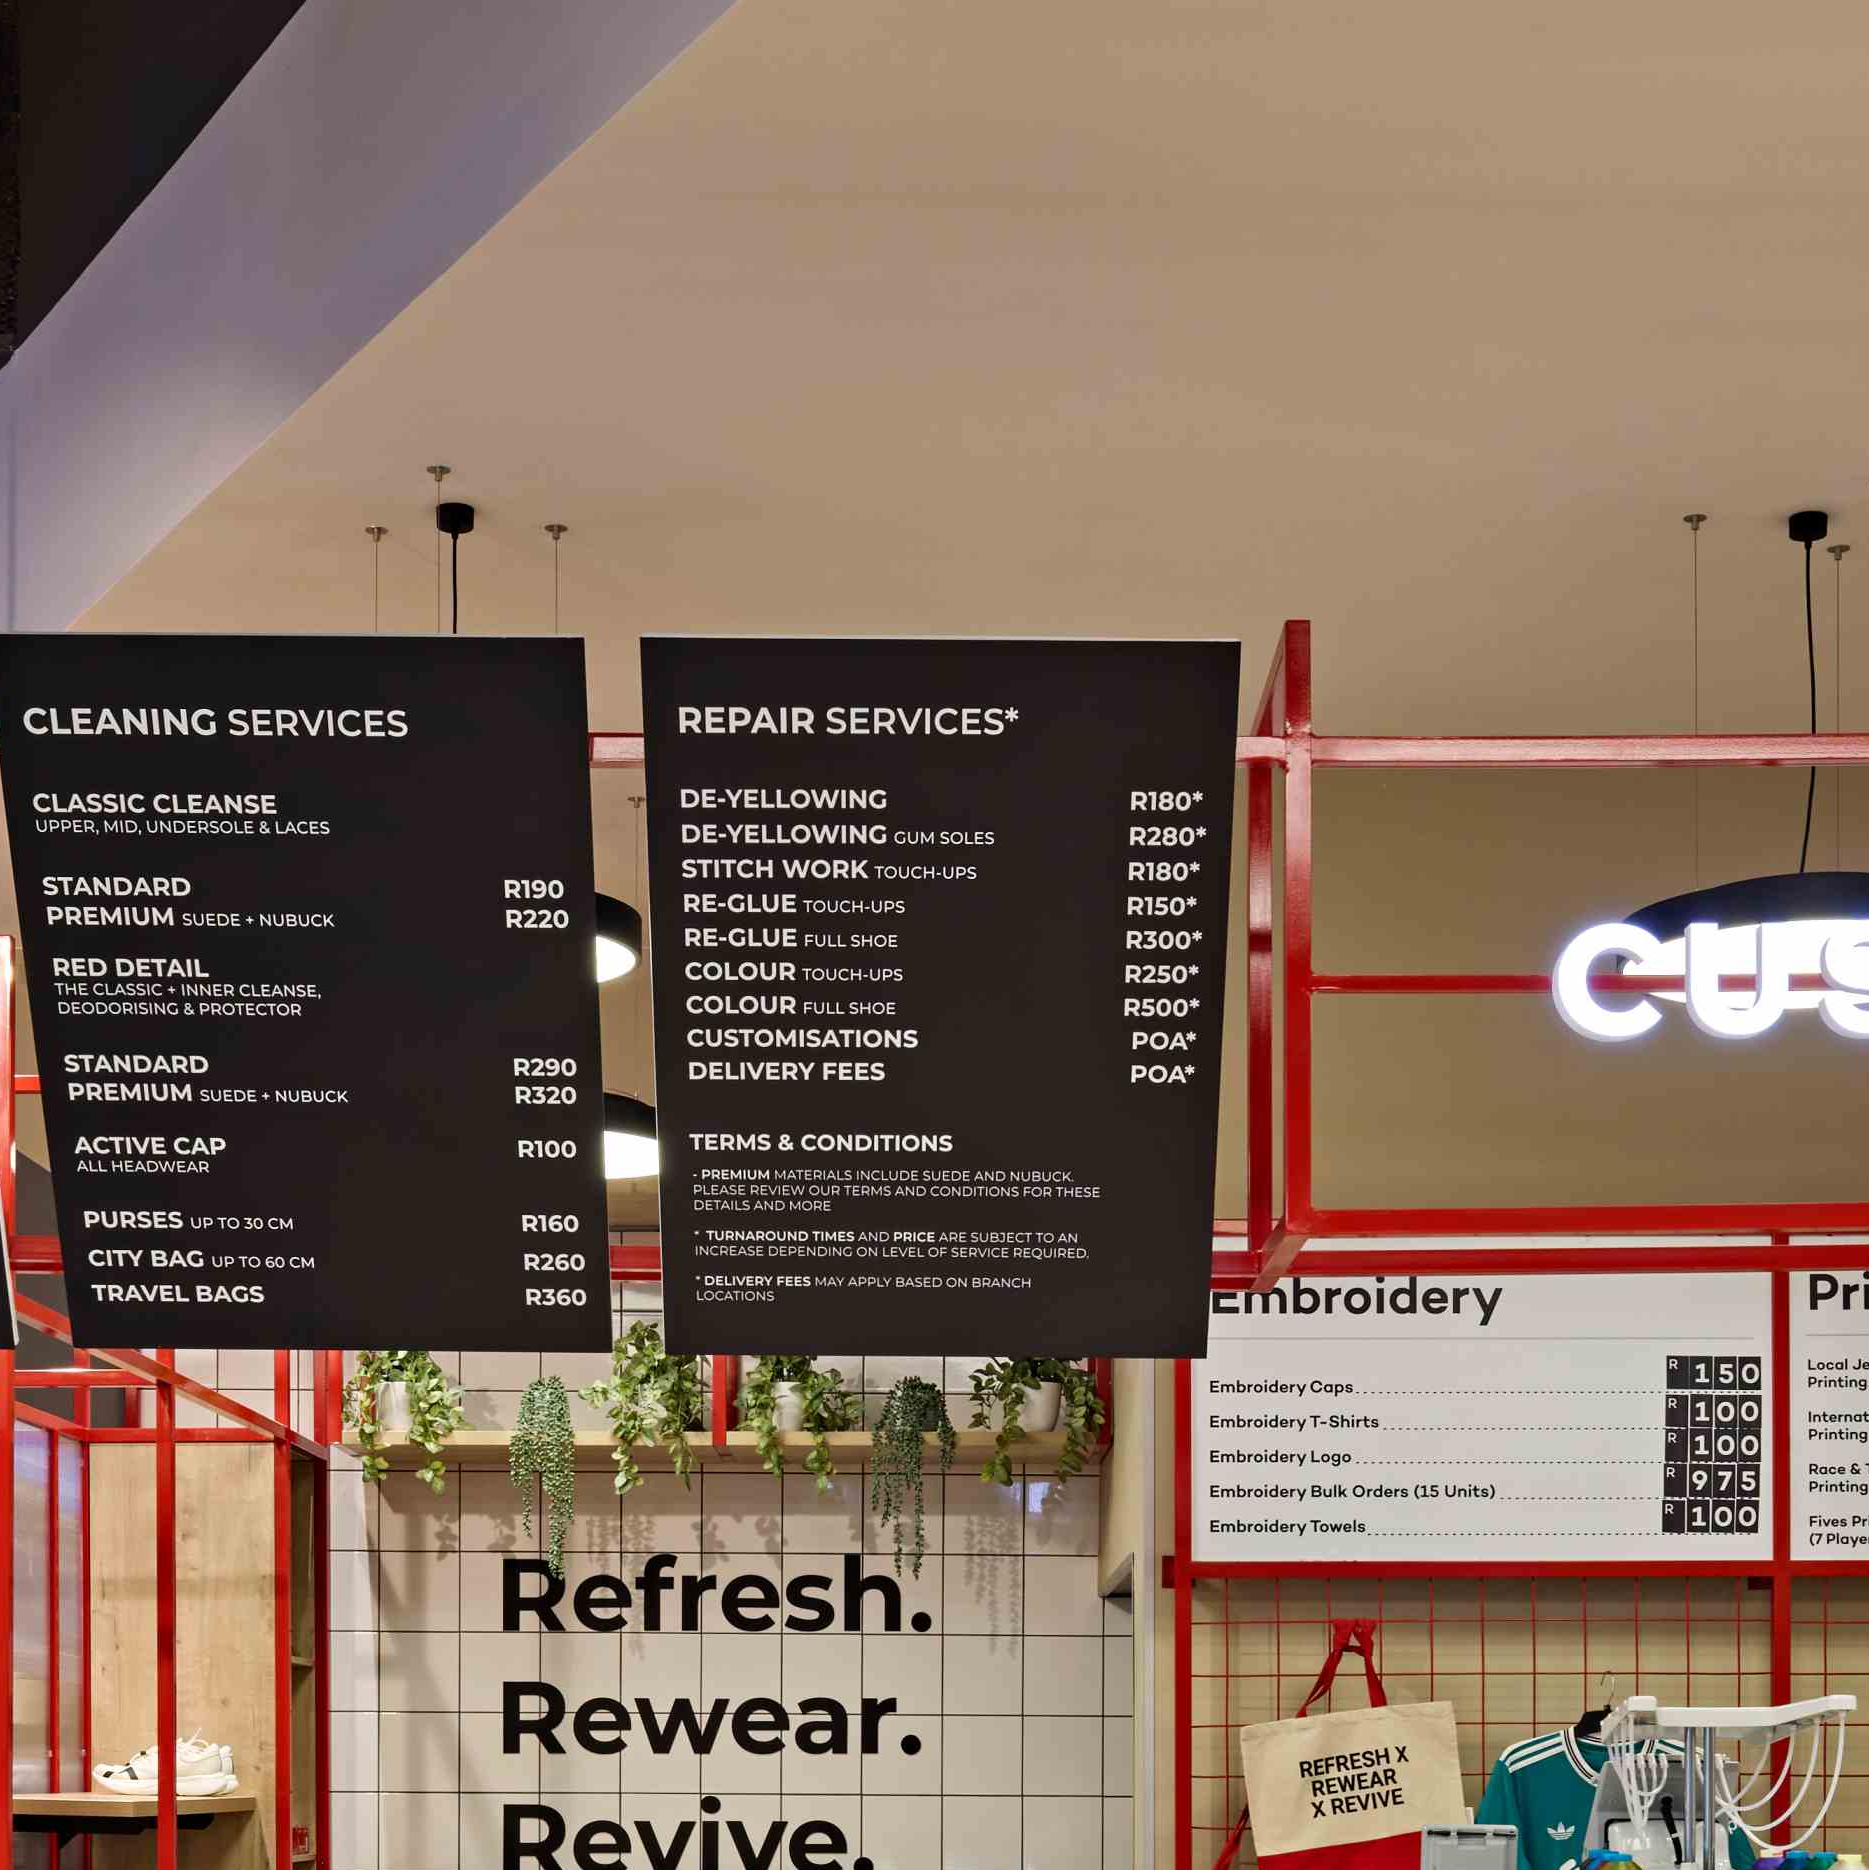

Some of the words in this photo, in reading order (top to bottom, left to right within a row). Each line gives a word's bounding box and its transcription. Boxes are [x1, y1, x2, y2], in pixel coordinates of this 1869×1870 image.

[23, 707, 217, 736] CLEANING
[227, 708, 409, 738] SERVICES
[678, 706, 815, 734] REPAIR
[32, 792, 146, 814] CLASSIC
[152, 793, 278, 815] CLEANSE
[35, 819, 100, 835] UPPER,
[103, 819, 142, 836] MID,
[146, 820, 255, 834] UNDERSOLE
[259, 820, 271, 834] &
[275, 820, 331, 835] LACES
[681, 858, 774, 879] STITCH
[781, 859, 869, 879] WORK
[873, 865, 977, 880] TOUCH-UPS
[684, 927, 798, 948] RE-GLUE
[804, 934, 847, 948] FULL
[850, 934, 898, 948] SHOE
[52, 957, 108, 977] RED
[115, 958, 210, 978] DETAIL
[57, 1001, 179, 1016] DEODORISING
[183, 1002, 195, 1016] &
[199, 1002, 302, 1017] PROTECTOR
[686, 1028, 919, 1049] CUSTOMISATIONS
[74, 1136, 167, 1155] ACTIVE
[173, 1136, 227, 1156] CAP
[517, 1139, 577, 1159] R100
[688, 1133, 772, 1151] TERMS
[777, 1133, 794, 1151] &
[800, 1133, 954, 1153] CONDITIONS
[693, 1184, 746, 1196] PLEASE
[750, 1184, 805, 1196] REVIEW
[808, 1184, 841, 1196] OUR
[843, 1185, 892, 1197] TERMS
[894, 1185, 927, 1197] AND
[930, 1185, 1020, 1198] CONDITIONS
[1023, 1186, 1052, 1198] FOR
[1055, 1186, 1100, 1198] THESE
[83, 1210, 184, 1229] PURSES
[190, 1216, 214, 1230] UP
[216, 1217, 240, 1230] TO
[243, 1217, 264, 1230] 30
[267, 1217, 294, 1230] CM
[521, 1214, 579, 1233] R160
[90, 1284, 190, 1303] TRAVEL
[195, 1285, 265, 1304] BAGS
[525, 1288, 587, 1306] R360
[1807, 1358, 1848, 1371] Local
[1209, 1379, 1307, 1397] Embroidery
[1309, 1380, 1354, 1397] Caps
[1695, 1359, 1760, 1387] 150
[1808, 1376, 1868, 1392] Printing
[1209, 1484, 1307, 1502] Embroidery
[1310, 1484, 1348, 1498] Bulk
[1352, 1484, 1409, 1498] Orders
[1413, 1484, 1440, 1500] (15
[1444, 1483, 1496, 1500] Units)
[503, 1554, 932, 1633] Refresh.
[503, 1681, 922, 1756] Rewear.
[1299, 1749, 1390, 1778] REFRESH
[1395, 1746, 1409, 1762] X
[1311, 1768, 1397, 1797] REWEAR
[1312, 1801, 1326, 1818] X
[1331, 1788, 1404, 1815] REVIVE
